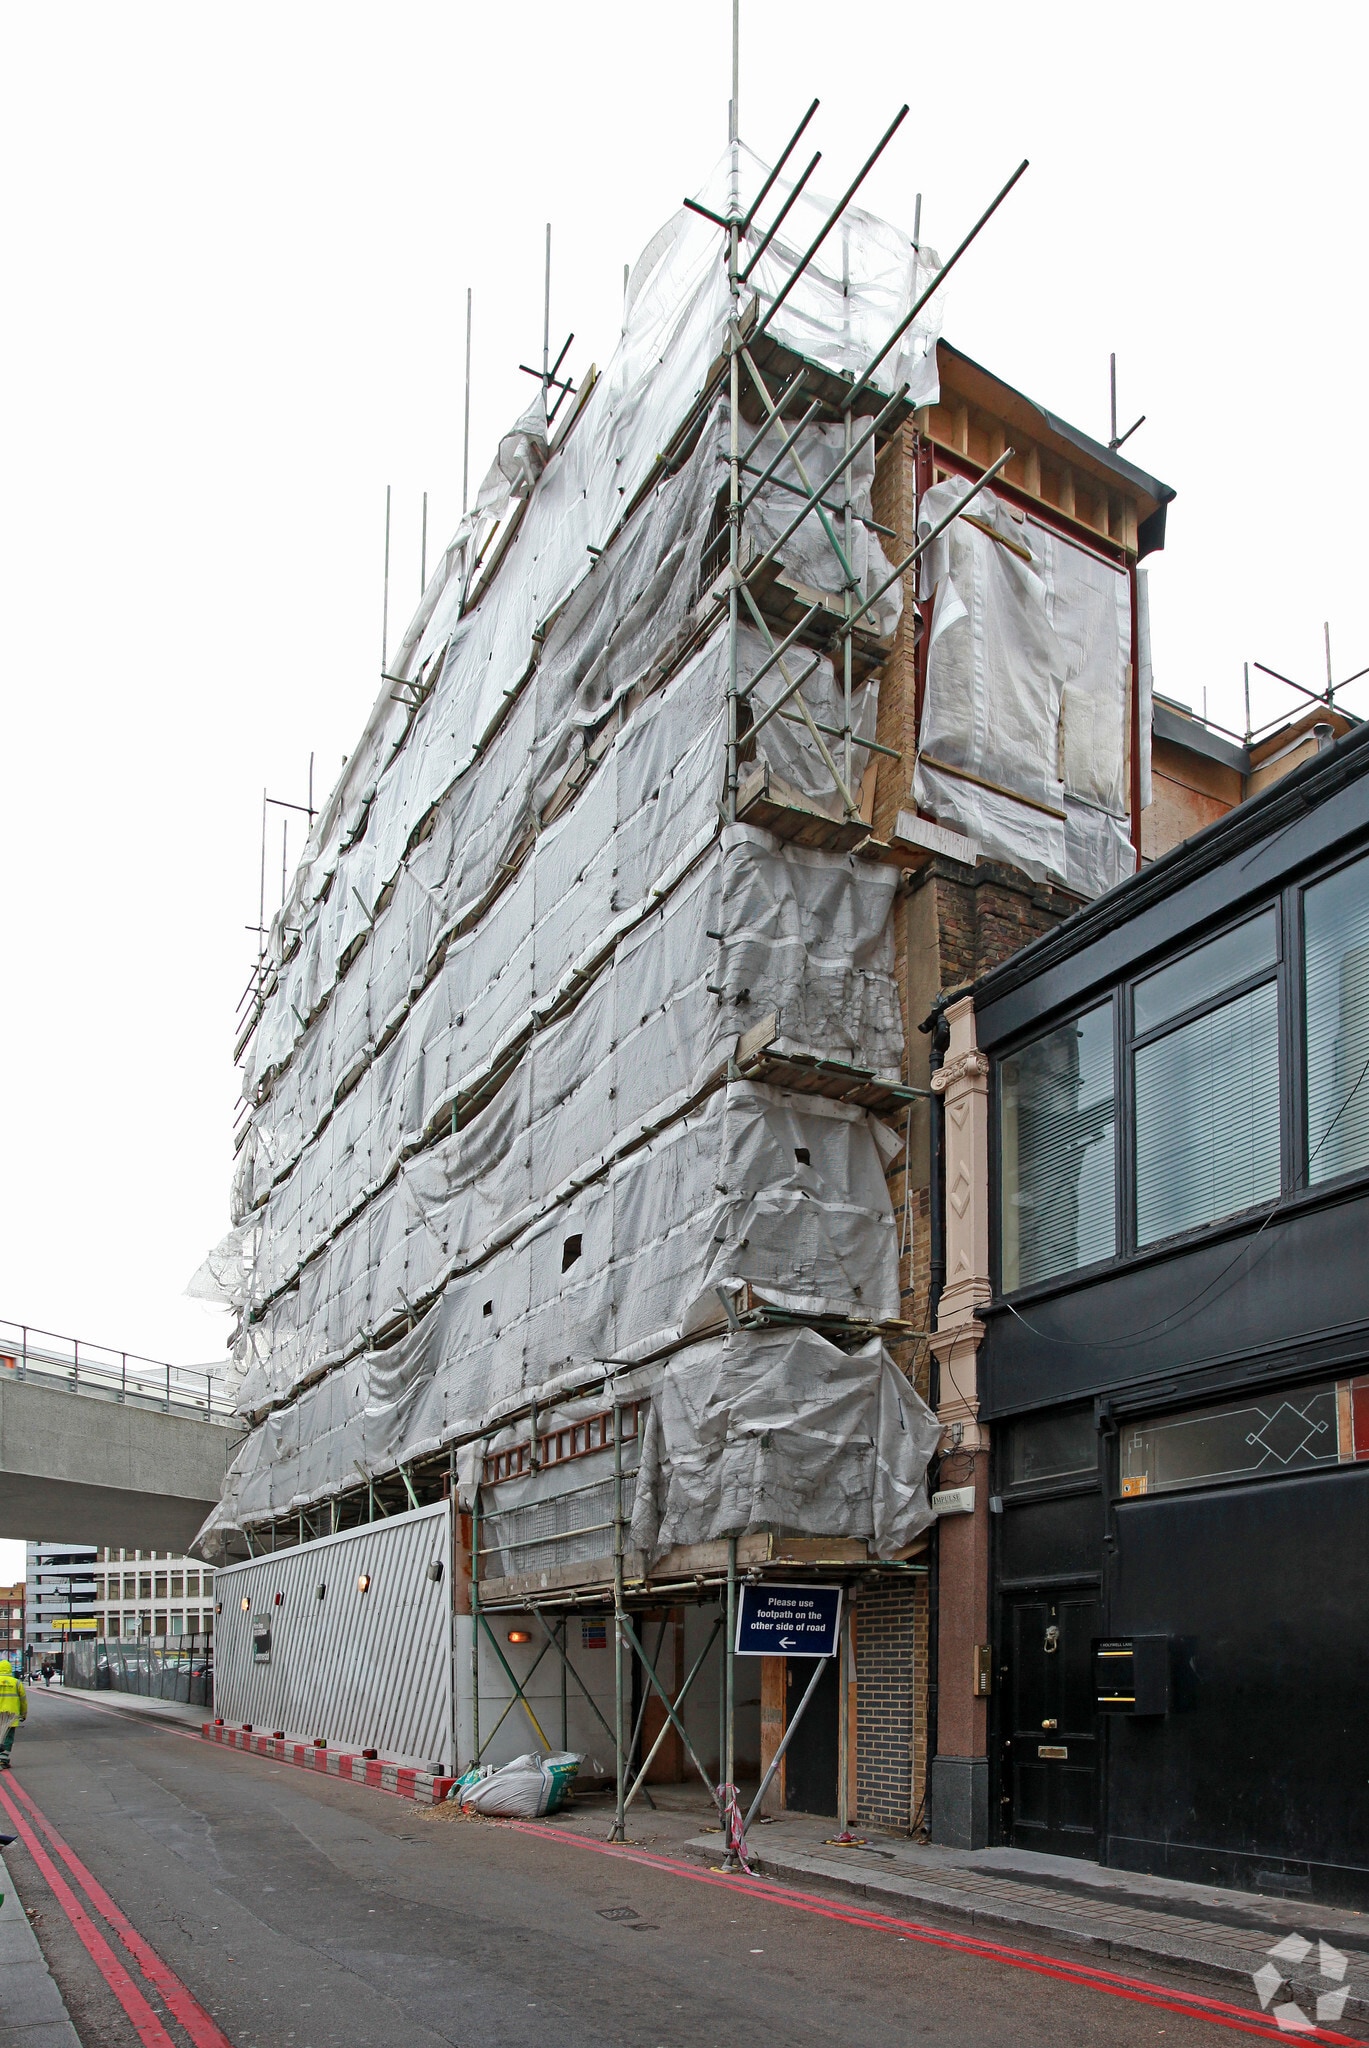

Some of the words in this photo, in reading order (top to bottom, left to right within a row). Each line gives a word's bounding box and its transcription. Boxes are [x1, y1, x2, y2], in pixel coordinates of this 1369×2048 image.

[933, 1493, 961, 1504] IMPULSE
[768, 1598, 796, 1606] Please
[757, 1609, 793, 1620] footpath
[808, 1612, 822, 1620] the
[750, 1622, 774, 1630] other
[776, 1622, 794, 1631] side
[796, 1623, 804, 1631] of
